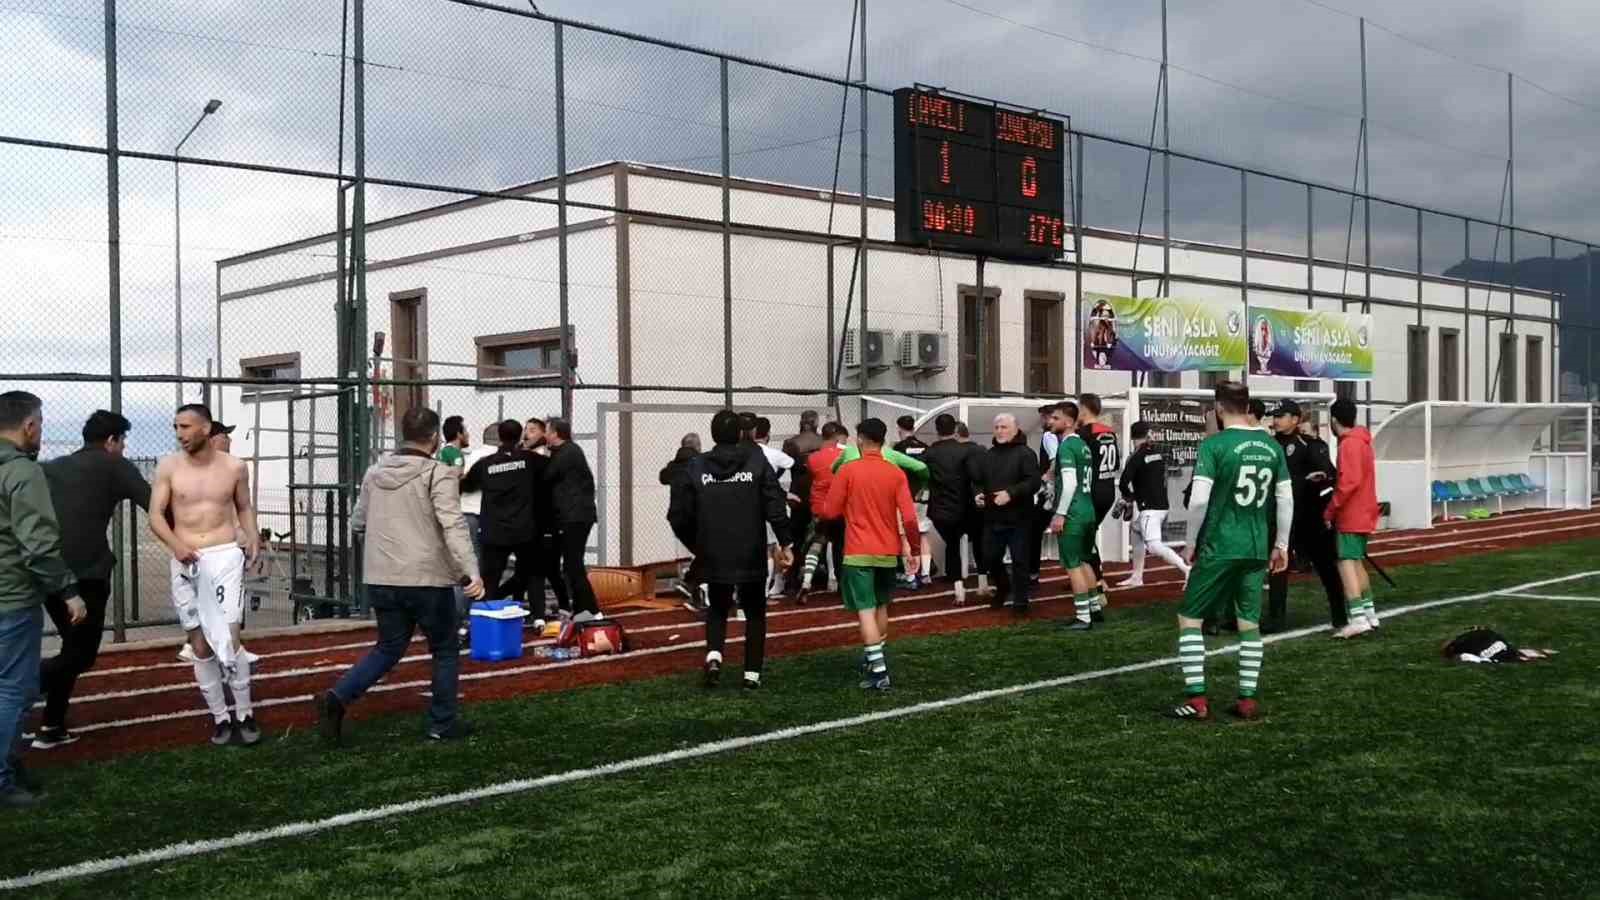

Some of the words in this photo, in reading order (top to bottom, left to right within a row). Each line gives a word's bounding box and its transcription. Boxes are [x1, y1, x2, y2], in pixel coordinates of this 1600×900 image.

[939, 140, 951, 184] 1
[1021, 155, 1038, 198] 0
[1183, 316, 1219, 338] ASLA
[1099, 444, 1117, 473] 20
[1234, 464, 1273, 508] 53
[215, 584, 225, 605] 8
